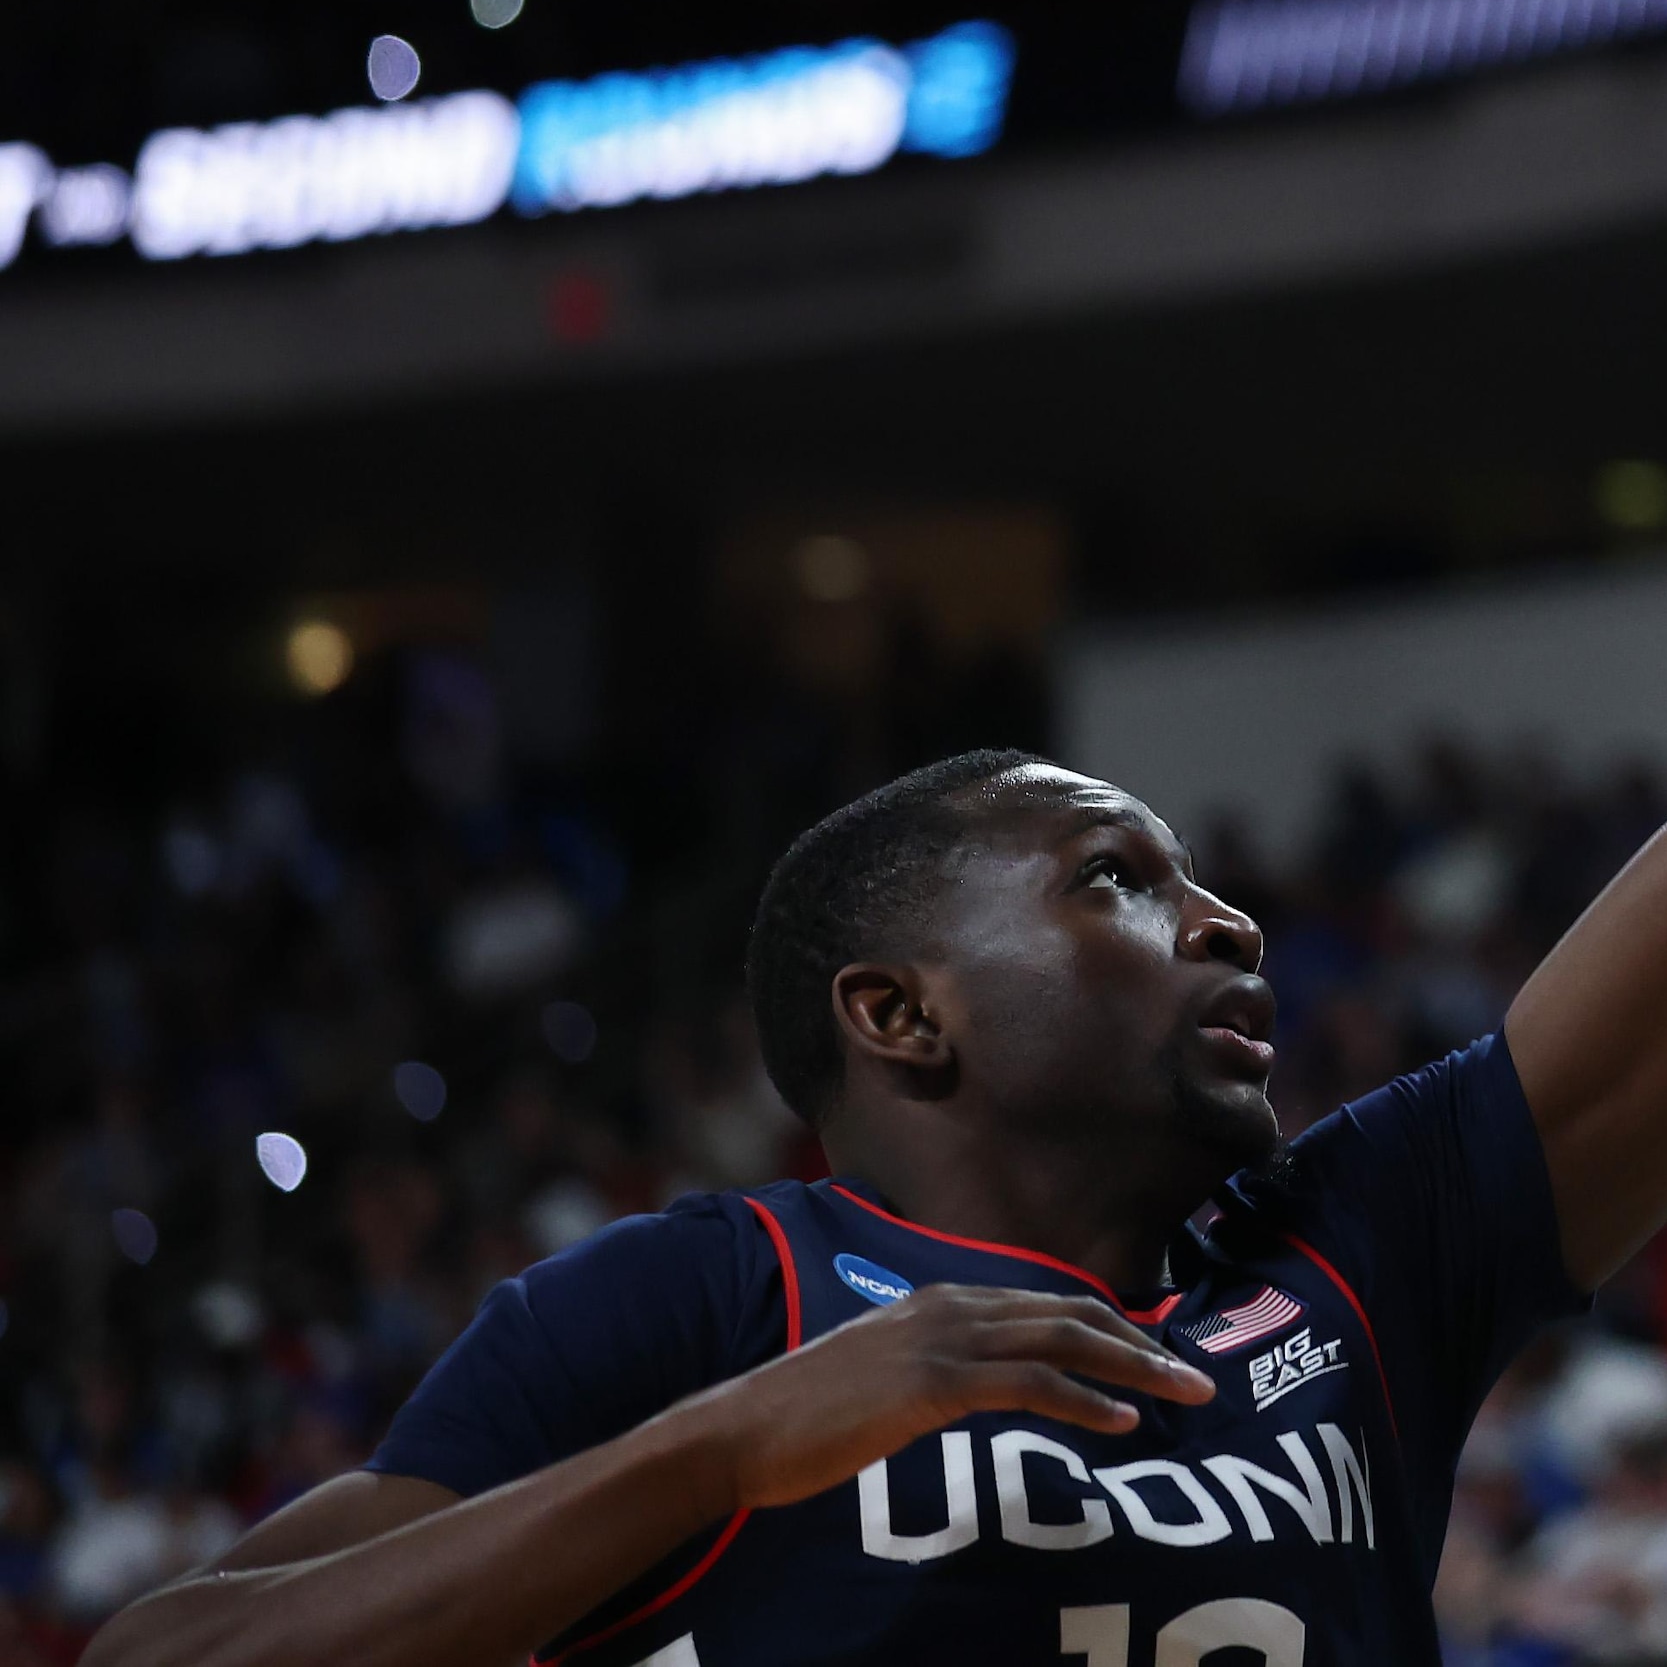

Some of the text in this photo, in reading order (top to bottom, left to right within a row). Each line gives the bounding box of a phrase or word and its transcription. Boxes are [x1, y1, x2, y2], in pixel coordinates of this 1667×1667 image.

[1248, 1325, 1312, 1382] BIG
[1252, 1337, 1342, 1402] EAST
[857, 1422, 1376, 1565] UCONN
